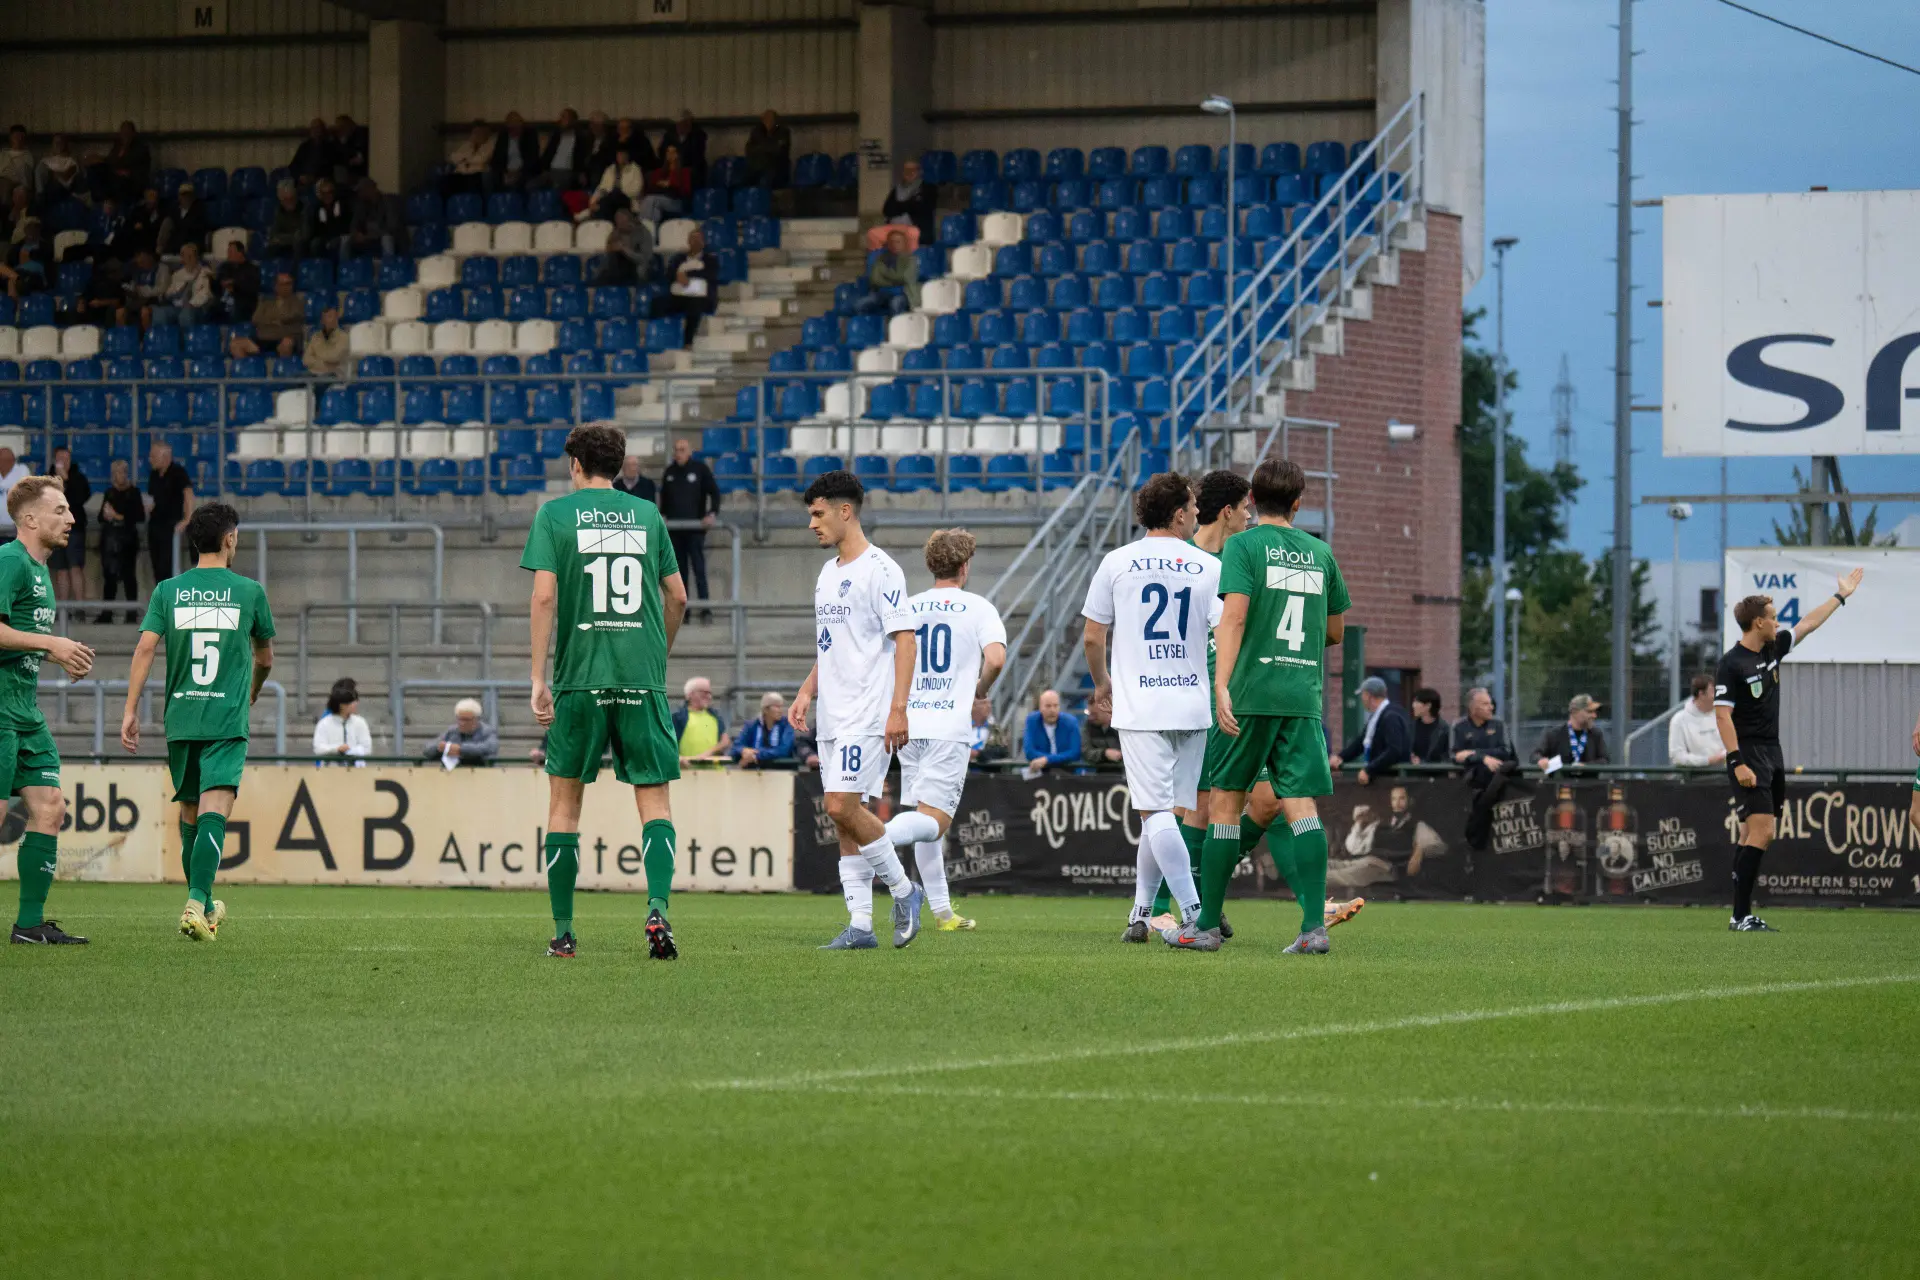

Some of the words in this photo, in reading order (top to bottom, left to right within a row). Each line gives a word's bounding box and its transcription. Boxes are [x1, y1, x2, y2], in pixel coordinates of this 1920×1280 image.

[195, 6, 212, 28] M
[584, 556, 642, 614] 19
[1753, 573, 1797, 589] VAK
[1141, 583, 1191, 641] 21
[1276, 595, 1305, 651] 4
[1777, 597, 1802, 628] 4
[192, 632, 220, 685] 5
[915, 623, 951, 673] 10
[840, 744, 862, 772] 18
[969, 809, 990, 826] NO
[1030, 788, 1112, 849] ROYAL
[1659, 816, 1680, 833] NO
[959, 822, 1005, 842] SUGAR
[1646, 830, 1697, 852] SUGAR
[439, 826, 774, 876] Archteten
[963, 843, 985, 861] NO
[1652, 852, 1674, 870] NO
[1848, 847, 1903, 868] Cola
[946, 852, 1011, 880] CALORIES
[1632, 862, 1703, 889] CALORIES
[1758, 875, 1843, 888] SOUTHERN
[1849, 877, 1894, 889] SLOW
